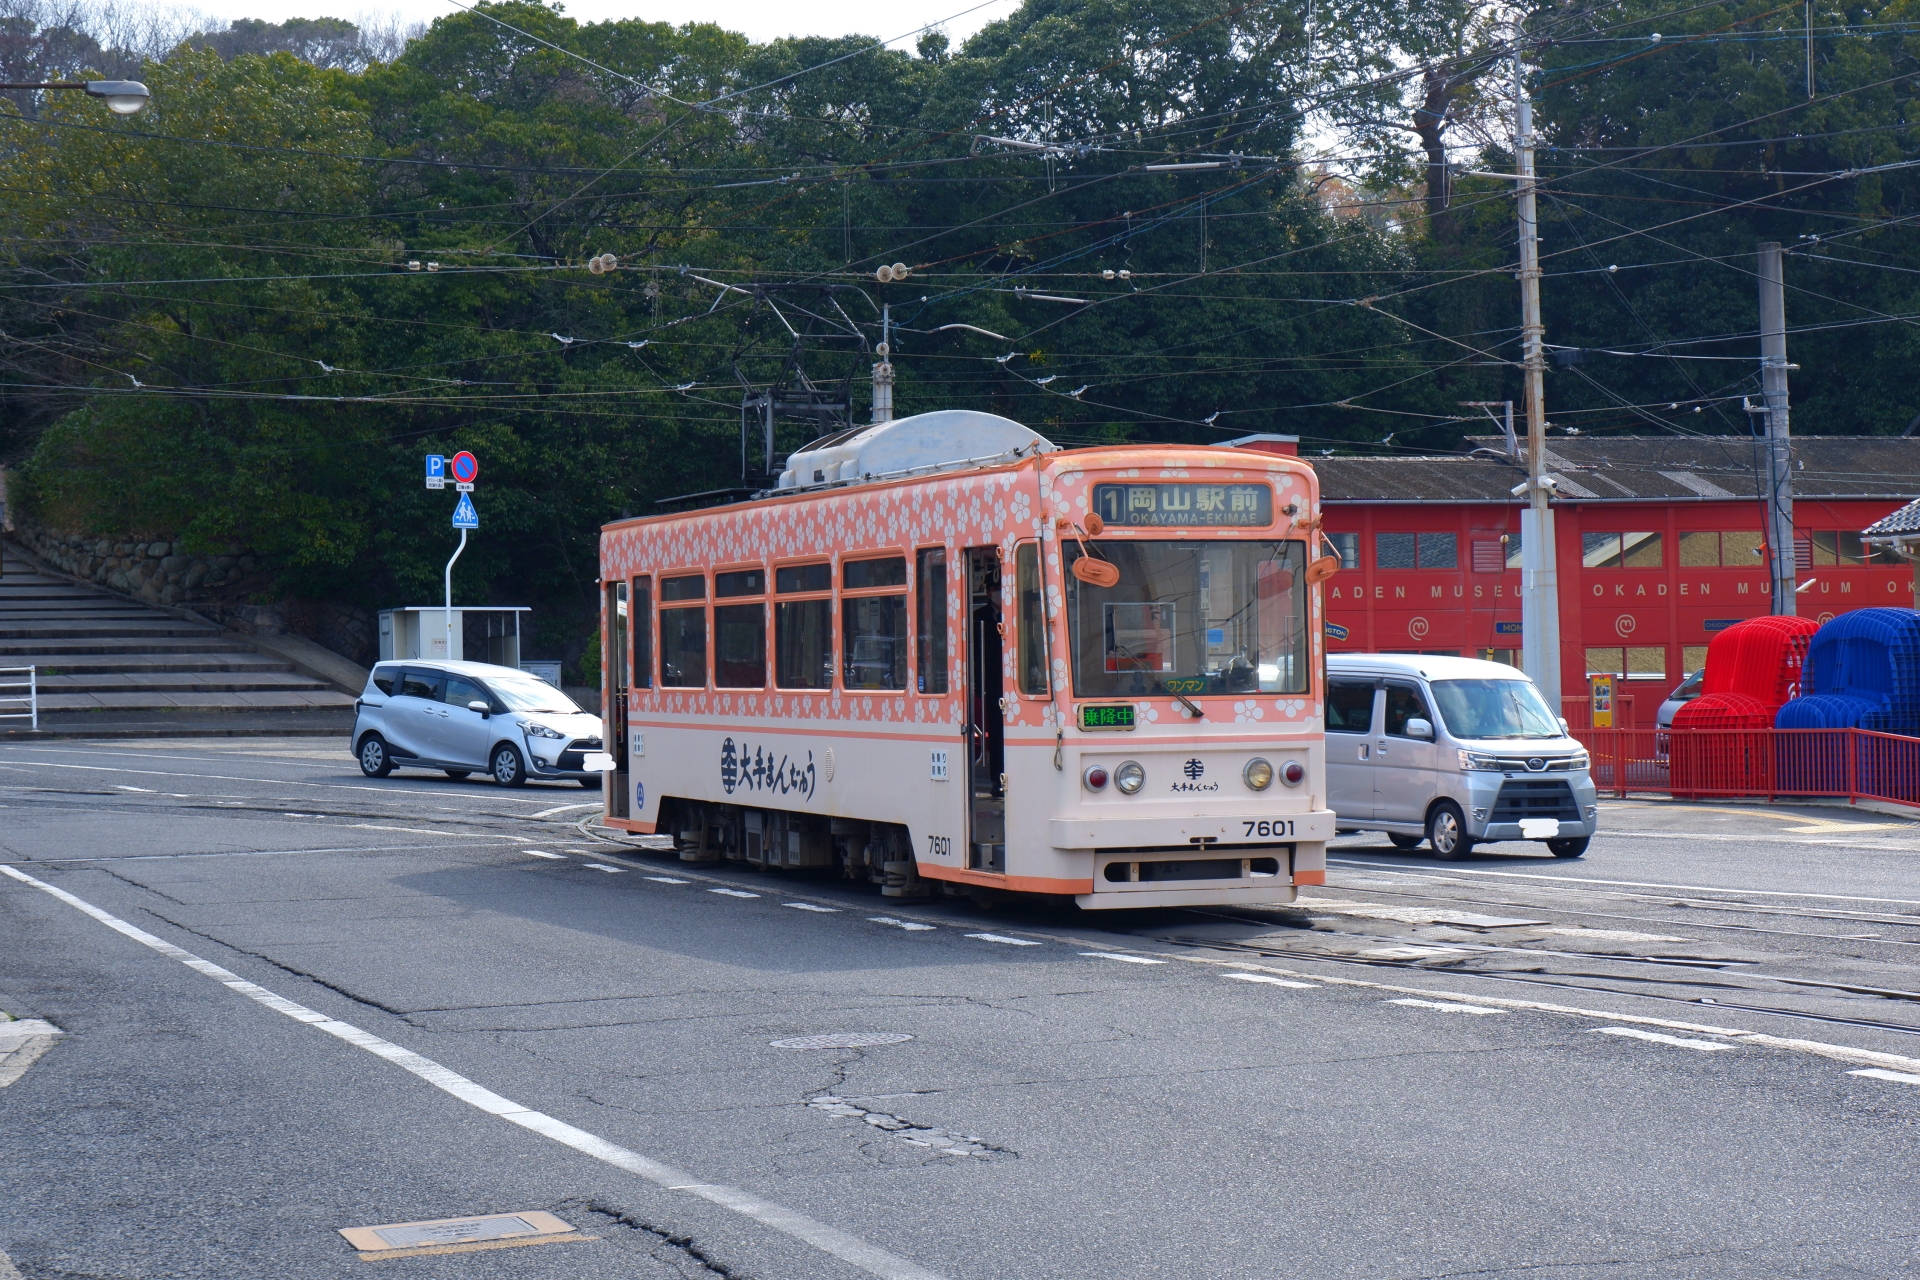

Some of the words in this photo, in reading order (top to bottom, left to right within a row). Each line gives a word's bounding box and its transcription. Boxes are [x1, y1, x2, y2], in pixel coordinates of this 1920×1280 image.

[430, 457, 442, 475] P
[1105, 491, 1118, 520] 1
[1128, 487, 1259, 512] 岡山駅前
[1130, 512, 1258, 525] OKAYAMA-EKIMAE
[1331, 586, 1405, 599] ADEN
[1431, 585, 1524, 598] MUSEU
[1593, 583, 1711, 597] OKADEN
[1737, 581, 1852, 596] MUUM
[1326, 627, 1347, 637] GTON
[1167, 680, 1204, 692] ワンマン
[1084, 707, 1134, 725] 乗降中
[1242, 820, 1295, 837] 7601
[928, 834, 951, 857] 7601
